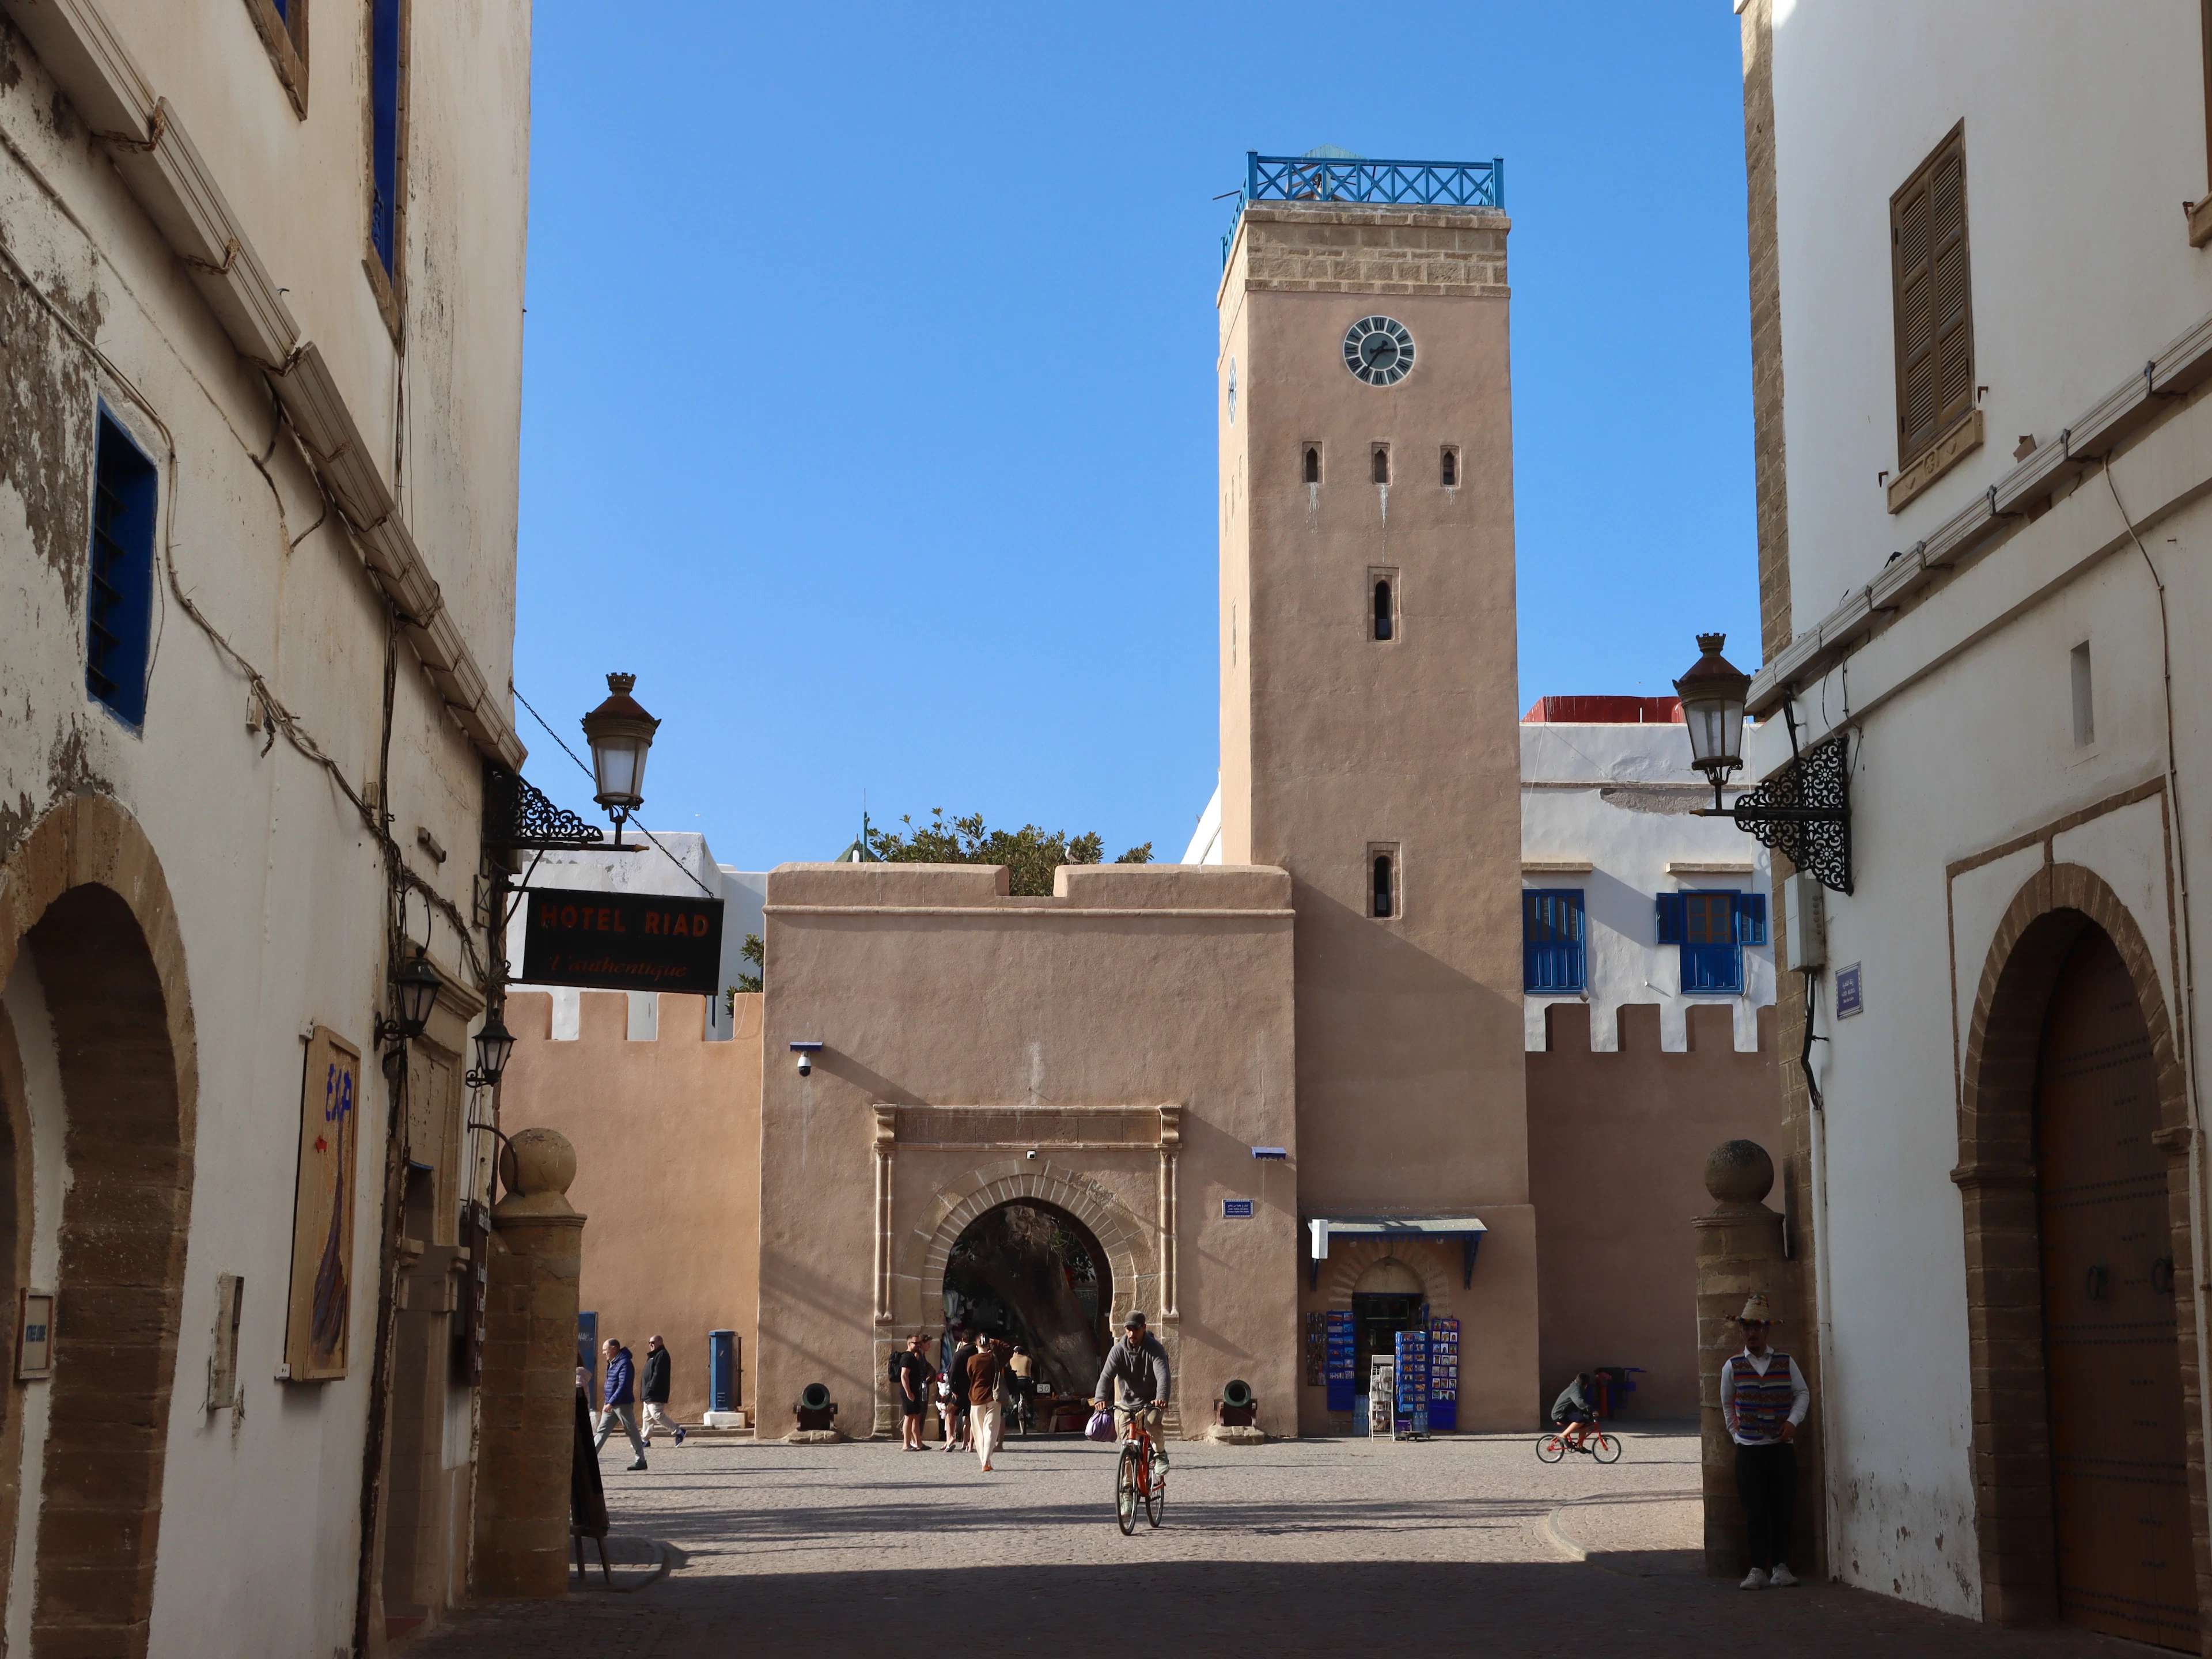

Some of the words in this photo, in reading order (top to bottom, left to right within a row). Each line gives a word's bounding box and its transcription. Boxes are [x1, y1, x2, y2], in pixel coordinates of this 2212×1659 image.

[1360, 321, 1371, 333] XI
[1374, 319, 1384, 331] XII
[540, 904, 626, 933] HOTEL
[645, 911, 709, 937] RIAD
